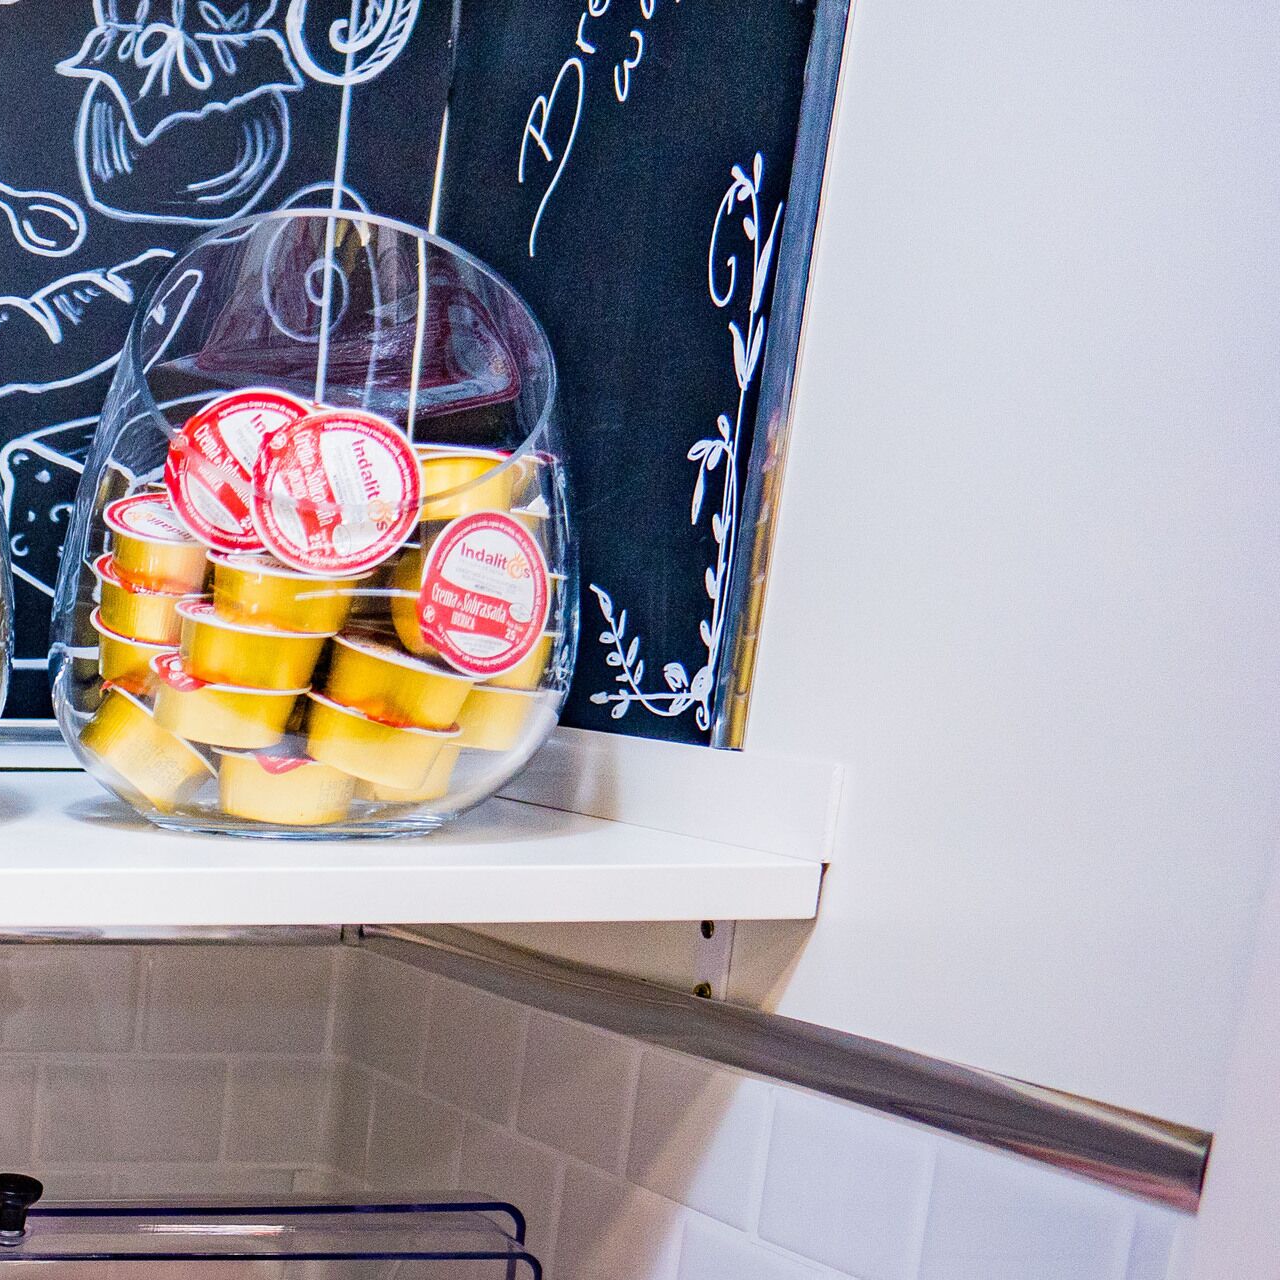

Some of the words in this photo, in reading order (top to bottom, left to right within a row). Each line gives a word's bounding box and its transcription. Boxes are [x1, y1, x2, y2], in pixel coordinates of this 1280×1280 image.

[193, 424, 221, 460] Crema
[460, 542, 531, 580] Indalitos
[432, 582, 458, 609] Crema
[463, 592, 507, 625] Sobrasada
